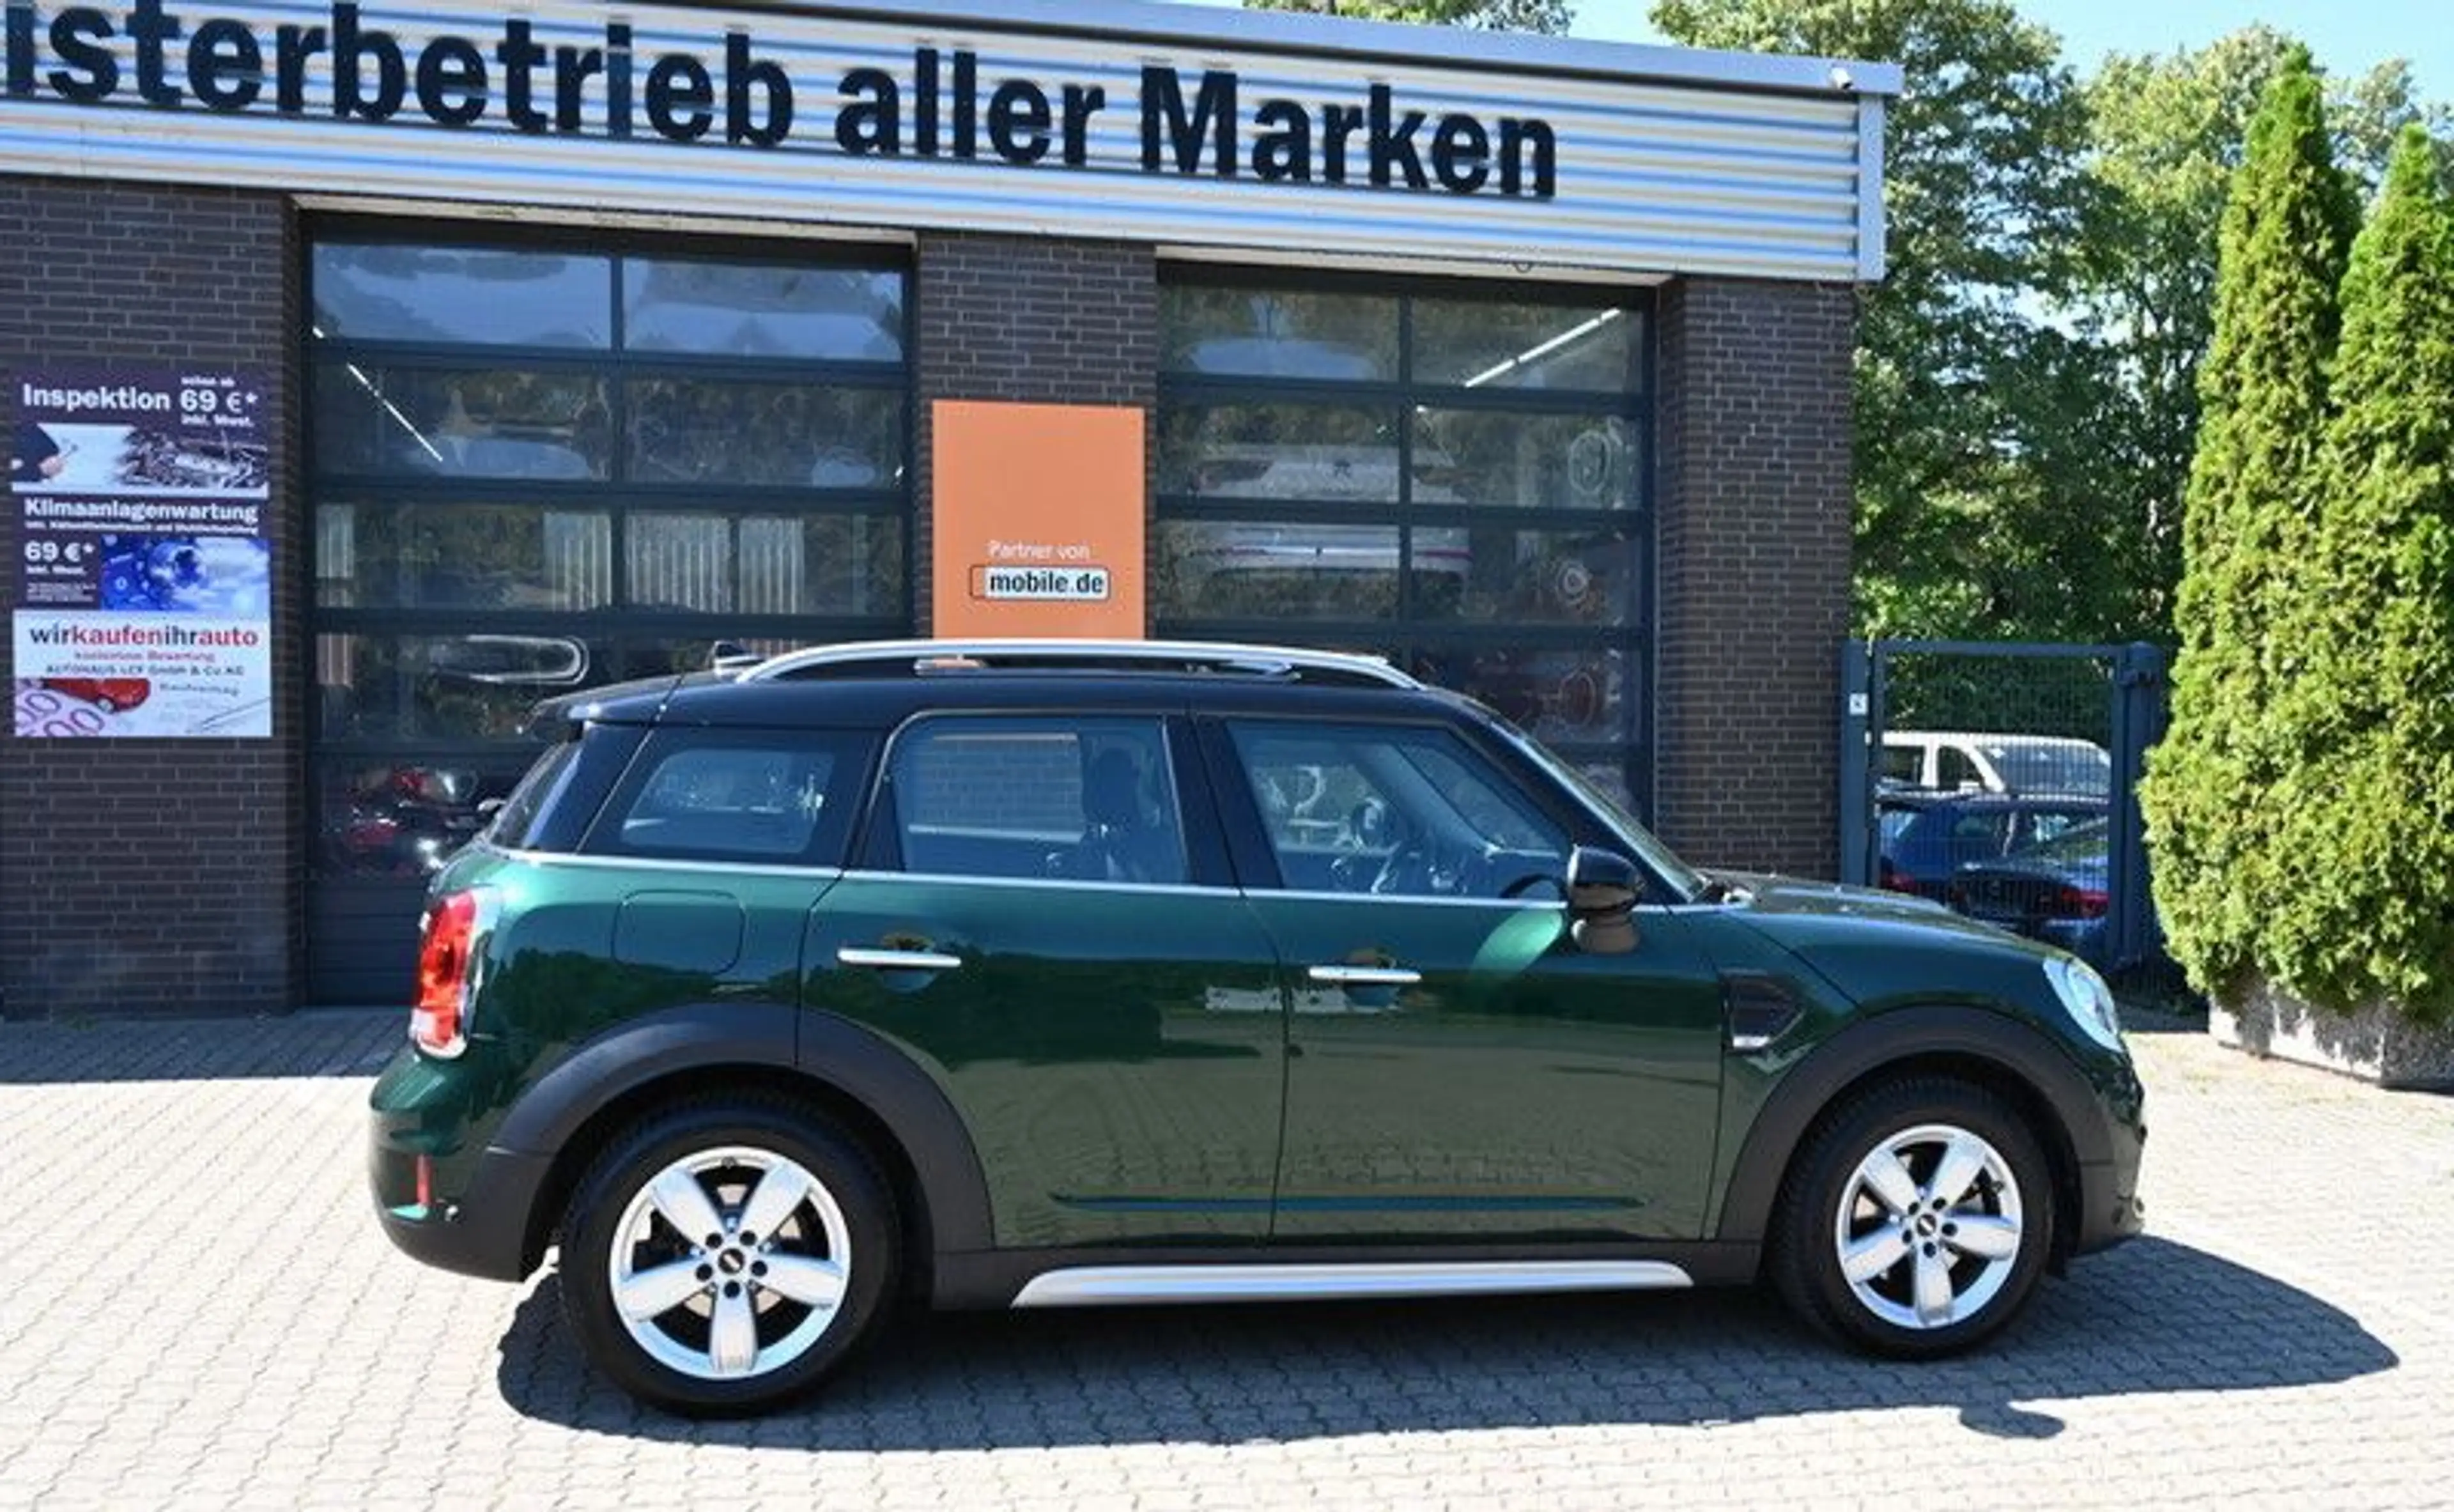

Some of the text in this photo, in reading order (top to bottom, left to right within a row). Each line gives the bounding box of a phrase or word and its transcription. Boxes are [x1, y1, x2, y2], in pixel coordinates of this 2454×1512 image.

[833, 47, 1106, 166] aller
[1140, 65, 1557, 199] Marken
[23, 383, 171, 412] Inspektion
[180, 389, 217, 413] 69
[24, 497, 259, 523] Klimaanlagenwartung
[24, 540, 59, 562] 69
[989, 539, 1090, 560] Partner von
[990, 571, 1104, 594] mobile.de
[29, 624, 259, 647] wirkaufenihrauto
